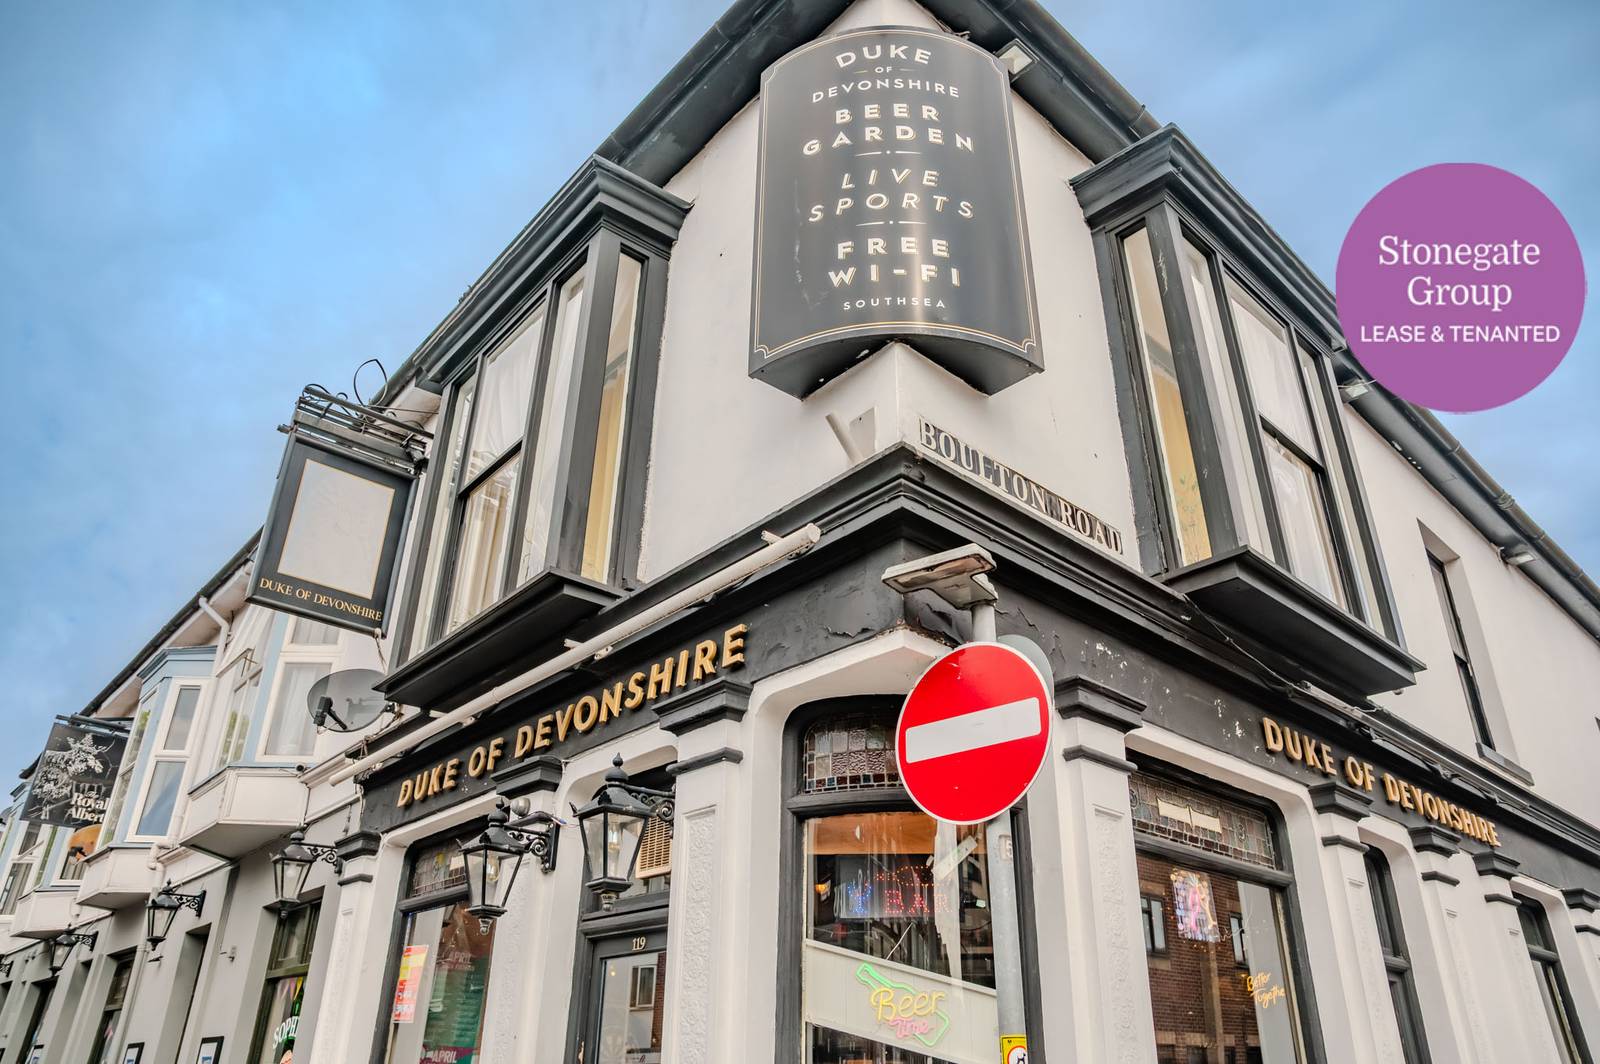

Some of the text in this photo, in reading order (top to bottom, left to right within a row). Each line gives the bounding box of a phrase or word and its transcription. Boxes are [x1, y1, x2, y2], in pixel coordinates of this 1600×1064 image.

[836, 44, 932, 68] DUKE
[812, 78, 960, 103] DEVONSHIRE
[835, 103, 941, 125] BEER
[802, 125, 975, 156] GARDEN
[841, 168, 940, 189] LIVE
[808, 192, 974, 222] SPORTS
[837, 236, 950, 260] FREE
[828, 263, 961, 288] WI-FI
[843, 297, 945, 311] SOUTHSEA
[920, 420, 1123, 553] BOULTON ROAD
[260, 578, 383, 621] DUKE OF DEVONSHIRE
[397, 623, 748, 808] DUKE OF DEVONSHIRE
[1263, 717, 1502, 847] DUKE OF DEVONSHIRE
[70, 792, 110, 810] Royal
[69, 807, 105, 822] Albert
[885, 890, 952, 912] BAR
[632, 937, 646, 951] 119
[871, 988, 945, 1020] Beer
[1250, 984, 1285, 1008] Togethe
[432, 1050, 457, 1063] APRIL
